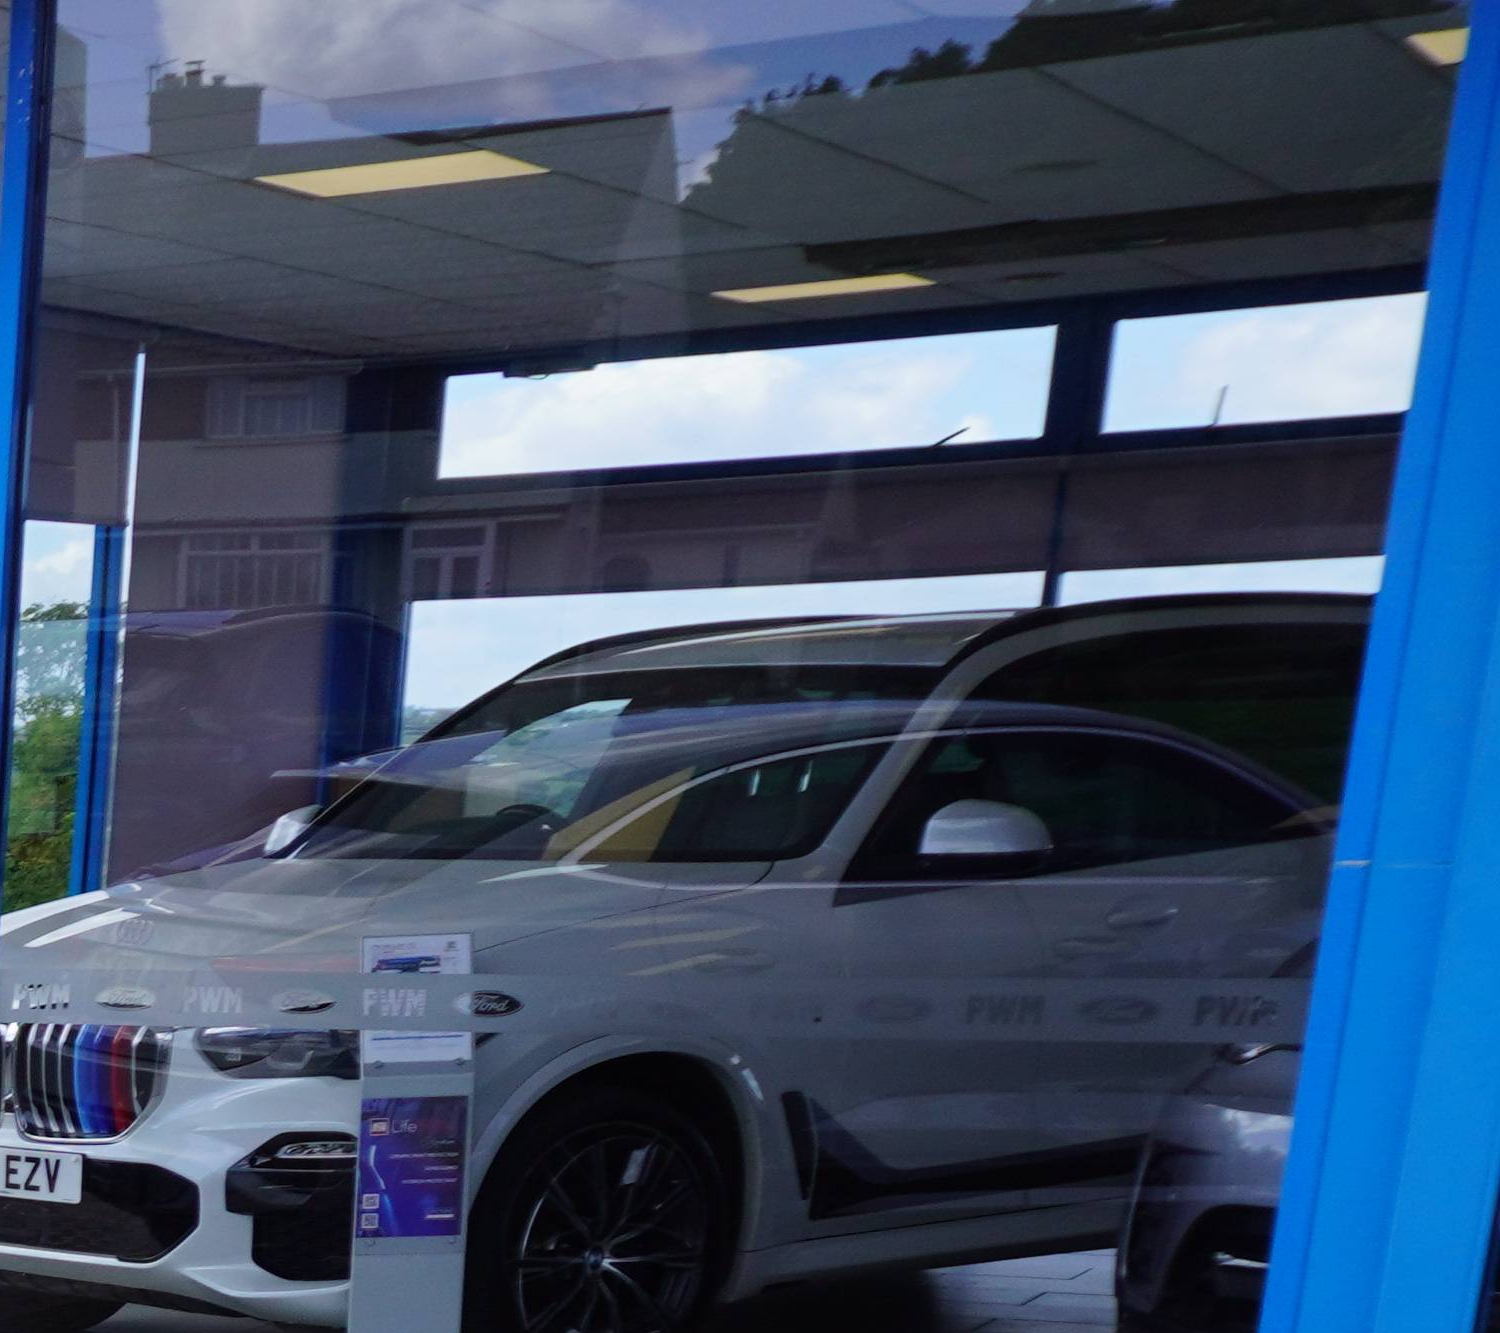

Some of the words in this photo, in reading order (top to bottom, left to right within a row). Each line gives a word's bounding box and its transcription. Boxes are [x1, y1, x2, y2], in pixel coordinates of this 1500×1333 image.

[11, 984, 70, 1010] PWM
[182, 985, 243, 1014] PWM
[362, 988, 427, 1017] PWM
[5, 1154, 61, 1193] EZV
